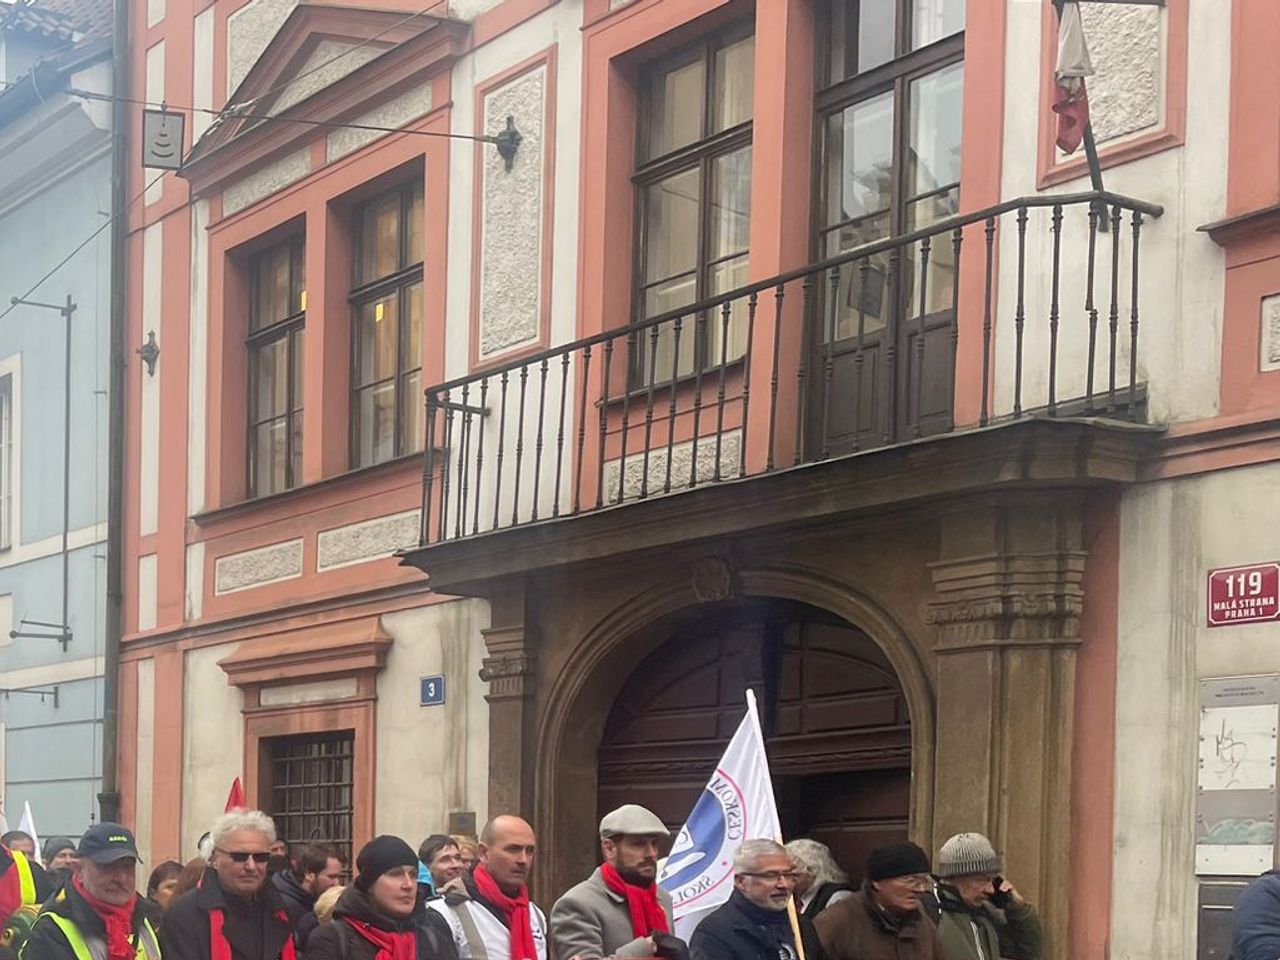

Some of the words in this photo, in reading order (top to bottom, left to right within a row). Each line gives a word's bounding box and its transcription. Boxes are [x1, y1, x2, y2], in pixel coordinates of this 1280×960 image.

[1225, 572, 1262, 598] 119
[1239, 597, 1275, 609] STRANA
[1225, 609, 1256, 619] PRAHA
[1259, 607, 1263, 615] 1
[428, 682, 435, 697] 3
